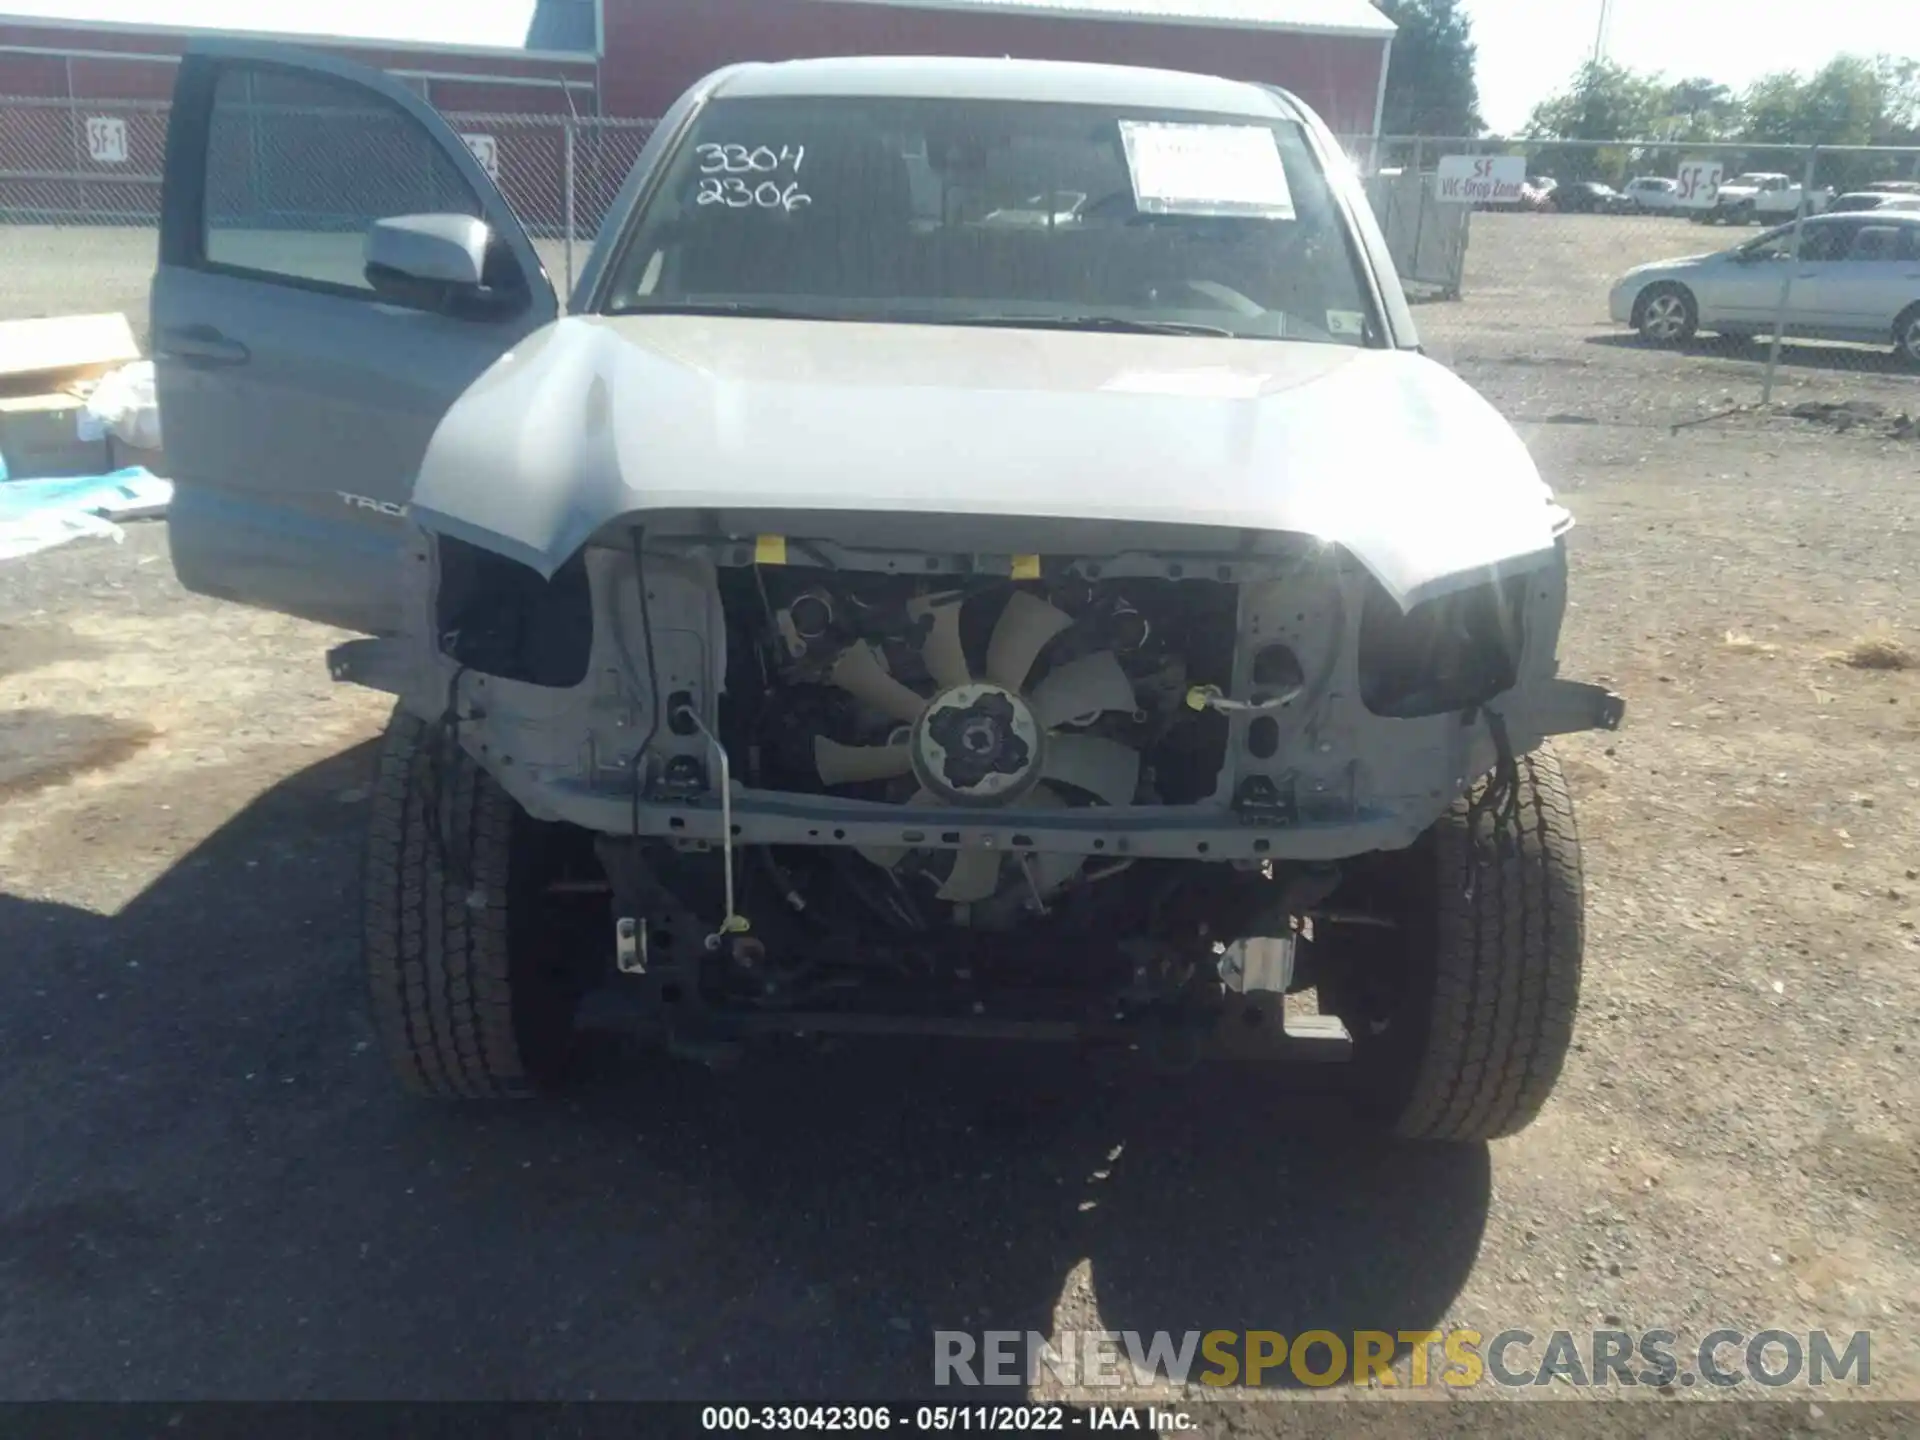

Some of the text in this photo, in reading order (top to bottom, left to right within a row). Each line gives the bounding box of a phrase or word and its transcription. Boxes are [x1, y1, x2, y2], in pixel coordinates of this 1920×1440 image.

[91, 123, 124, 156] SF-1
[696, 143, 804, 173] 3304
[1474, 159, 1493, 176] SF
[697, 178, 811, 211] 2306
[1678, 167, 1720, 200] SF-5
